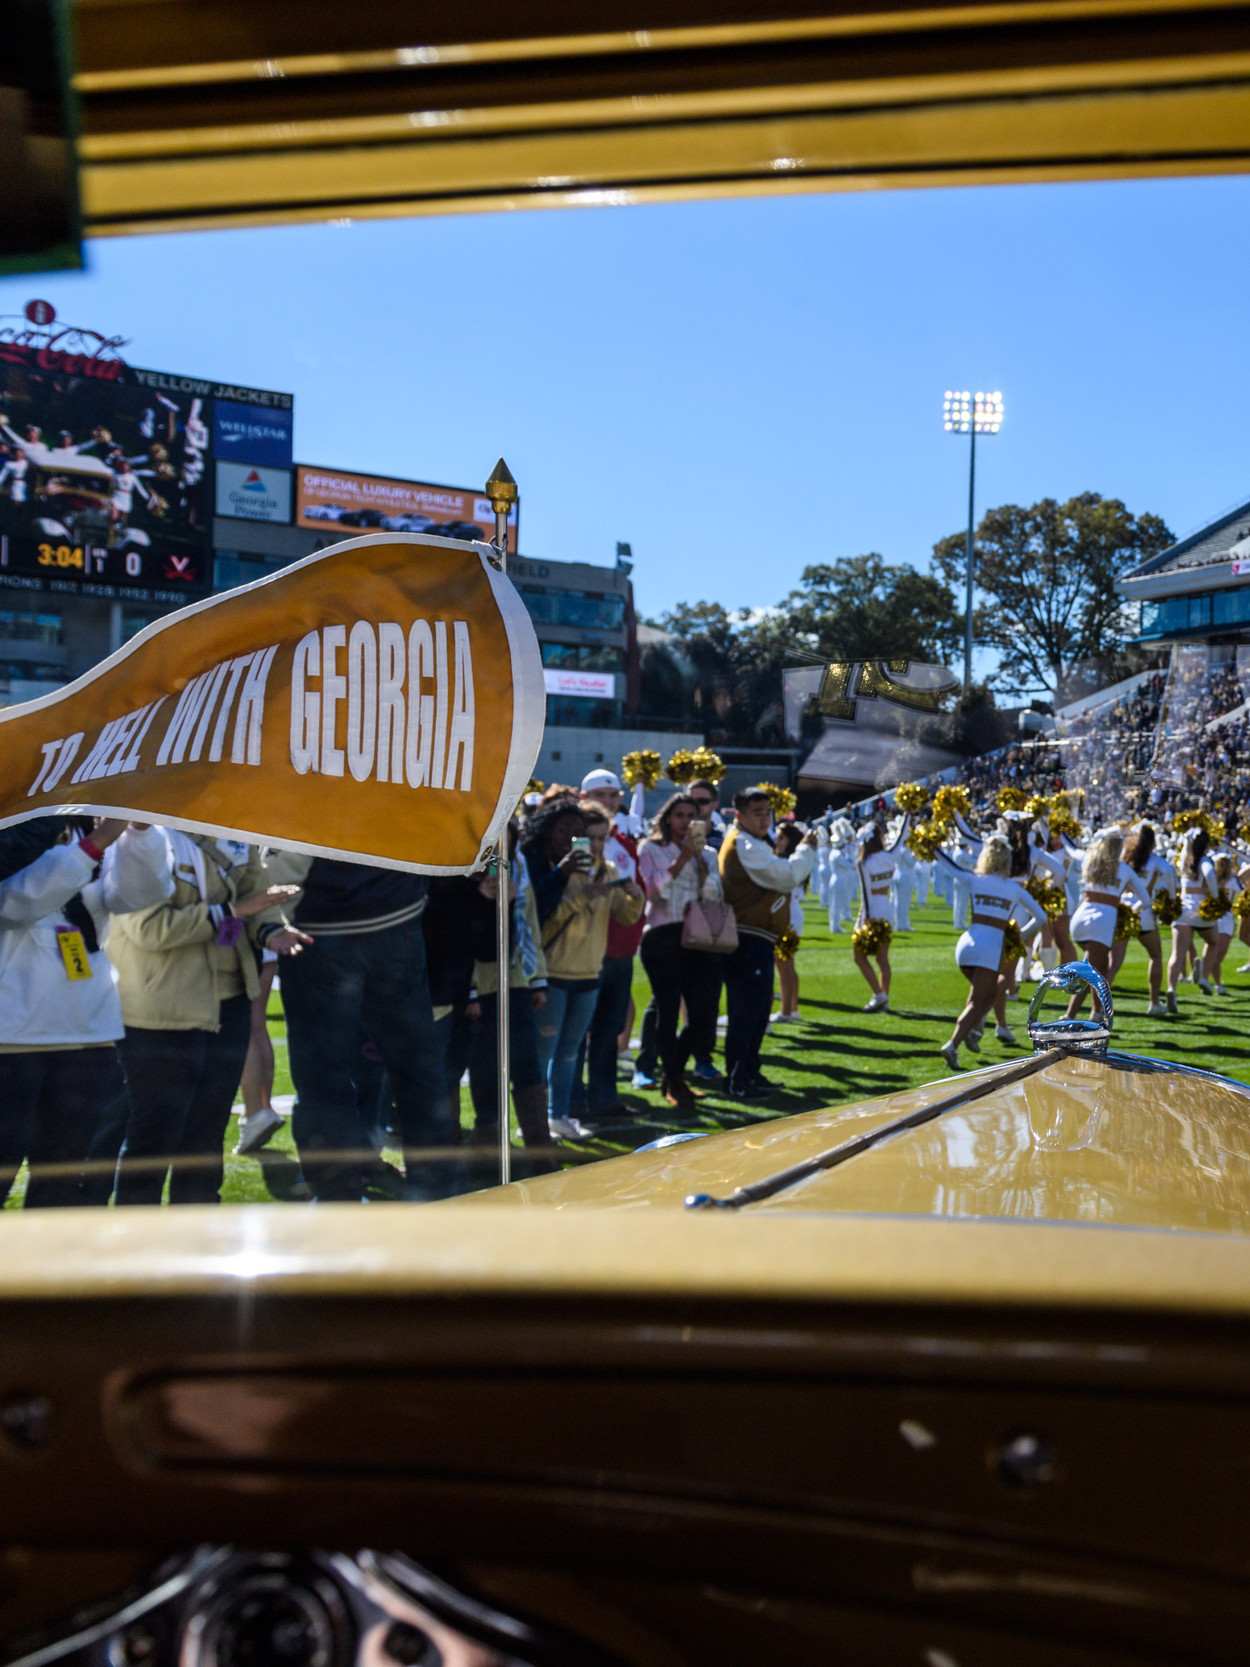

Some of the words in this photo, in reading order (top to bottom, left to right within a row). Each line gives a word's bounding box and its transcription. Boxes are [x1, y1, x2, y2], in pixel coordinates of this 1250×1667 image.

[135, 369, 211, 396] YELLOW
[213, 385, 292, 409] JACKETS
[228, 491, 278, 509] Georgia
[304, 474, 361, 493] OFFICIAL
[362, 483, 412, 499] LUXURY
[413, 490, 464, 508] VEHICLE
[234, 506, 272, 519] Power
[38, 543, 84, 569] 3:04
[27, 731, 85, 797] TO
[71, 694, 170, 783] HELL
[155, 644, 280, 766] WITH
[290, 619, 475, 792] GEORGIA
[975, 894, 1012, 911] TECH
[73, 956, 84, 973] 2
